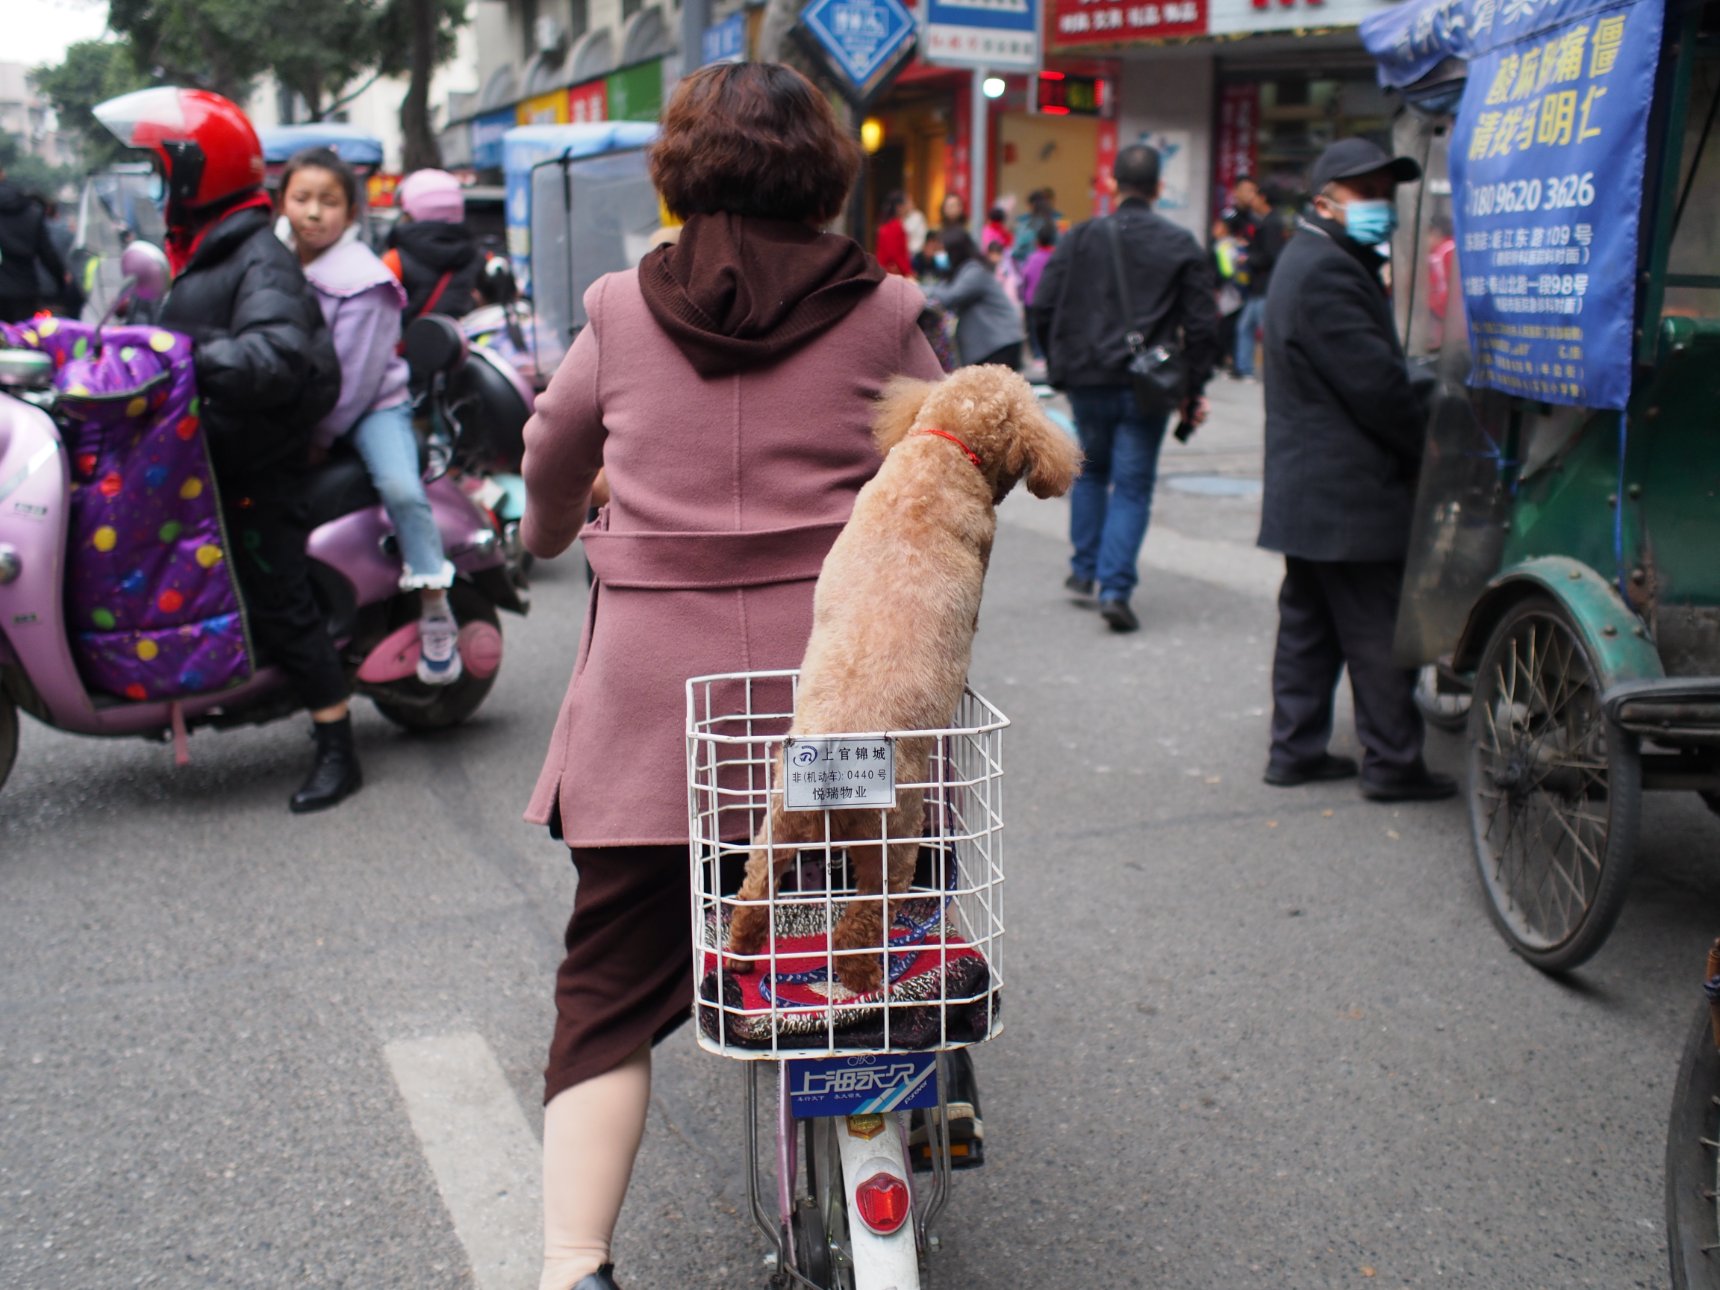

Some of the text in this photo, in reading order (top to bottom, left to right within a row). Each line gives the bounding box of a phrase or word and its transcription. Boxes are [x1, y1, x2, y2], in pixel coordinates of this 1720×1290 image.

[822, 747, 886, 761] 上官锦城
[812, 785, 867, 800] 悦瑞物业
[790, 1063, 914, 1096] 上海永久
